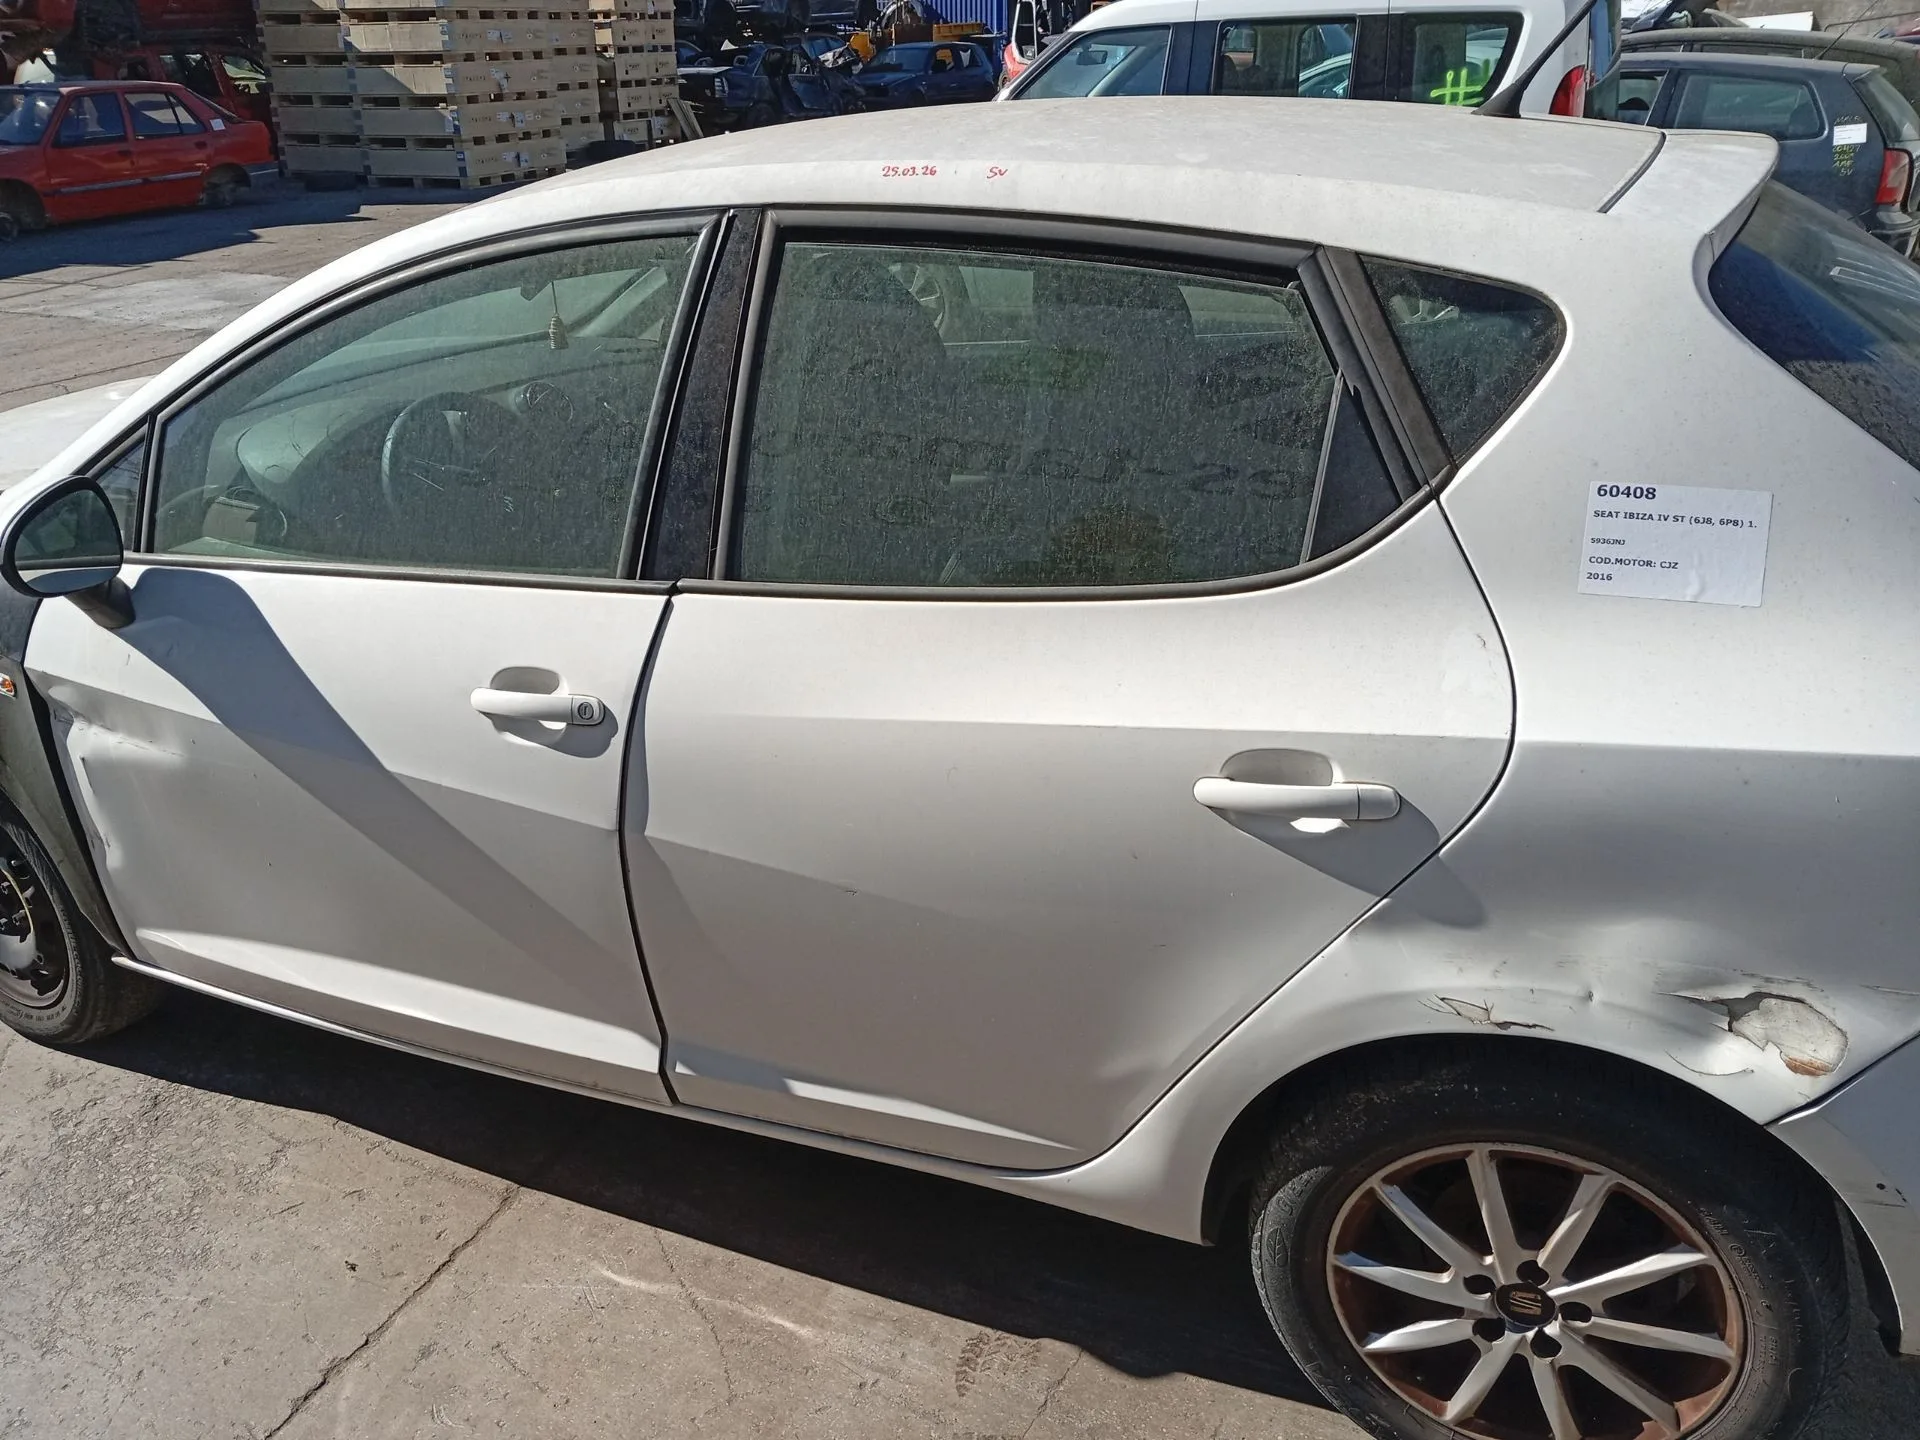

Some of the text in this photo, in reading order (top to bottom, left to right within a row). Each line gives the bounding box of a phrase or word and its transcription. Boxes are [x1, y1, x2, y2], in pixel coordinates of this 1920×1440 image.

[1596, 484, 1657, 500] 60408
[1593, 509, 1758, 528] SEAT IBIZA IV ST (6J8, 6P8) 1.
[1590, 537, 1626, 546] 5936JNJ
[1588, 556, 1679, 570] COD.MOTOR: CJZ
[1586, 572, 1613, 581] 2016
